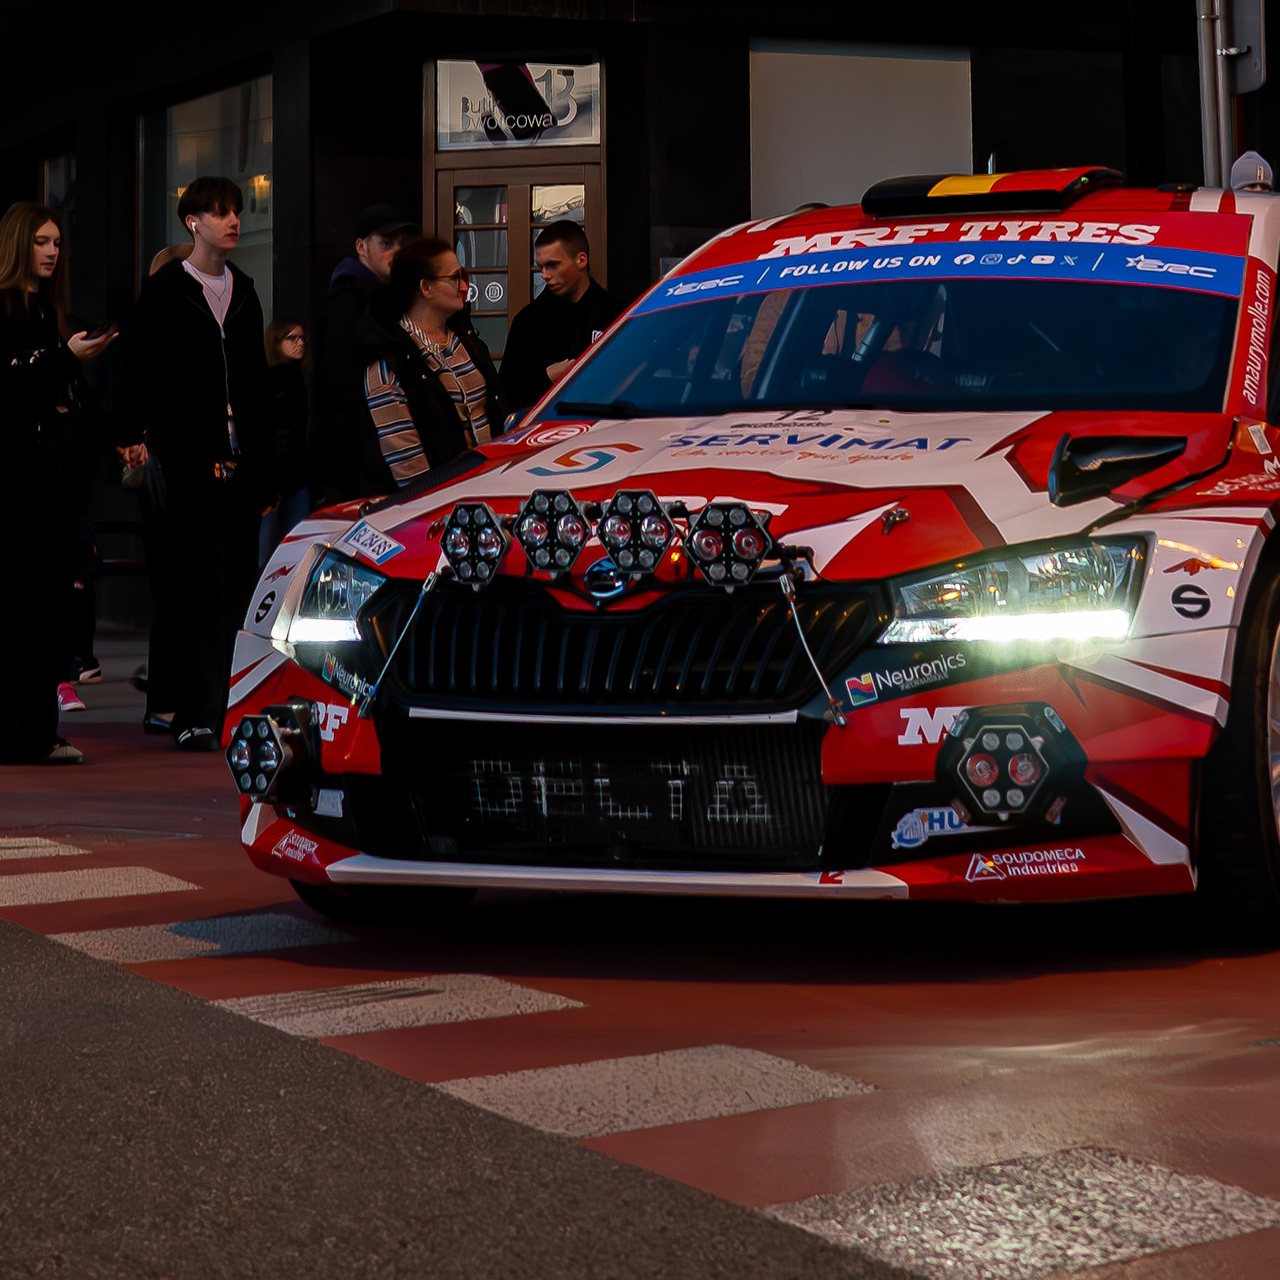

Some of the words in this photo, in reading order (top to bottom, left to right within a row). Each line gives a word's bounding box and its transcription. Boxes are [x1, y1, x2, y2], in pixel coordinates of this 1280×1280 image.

[534, 68, 579, 127] 13
[756, 223, 950, 261] MRF
[958, 219, 1161, 246] TYRES
[779, 258, 870, 279] FOLLOW
[872, 256, 904, 269] US
[908, 254, 942, 267] ON
[1242, 268, 1272, 405] amaurymolle.com
[667, 433, 972, 450] SERVIMAT
[875, 652, 968, 691] Neuronics
